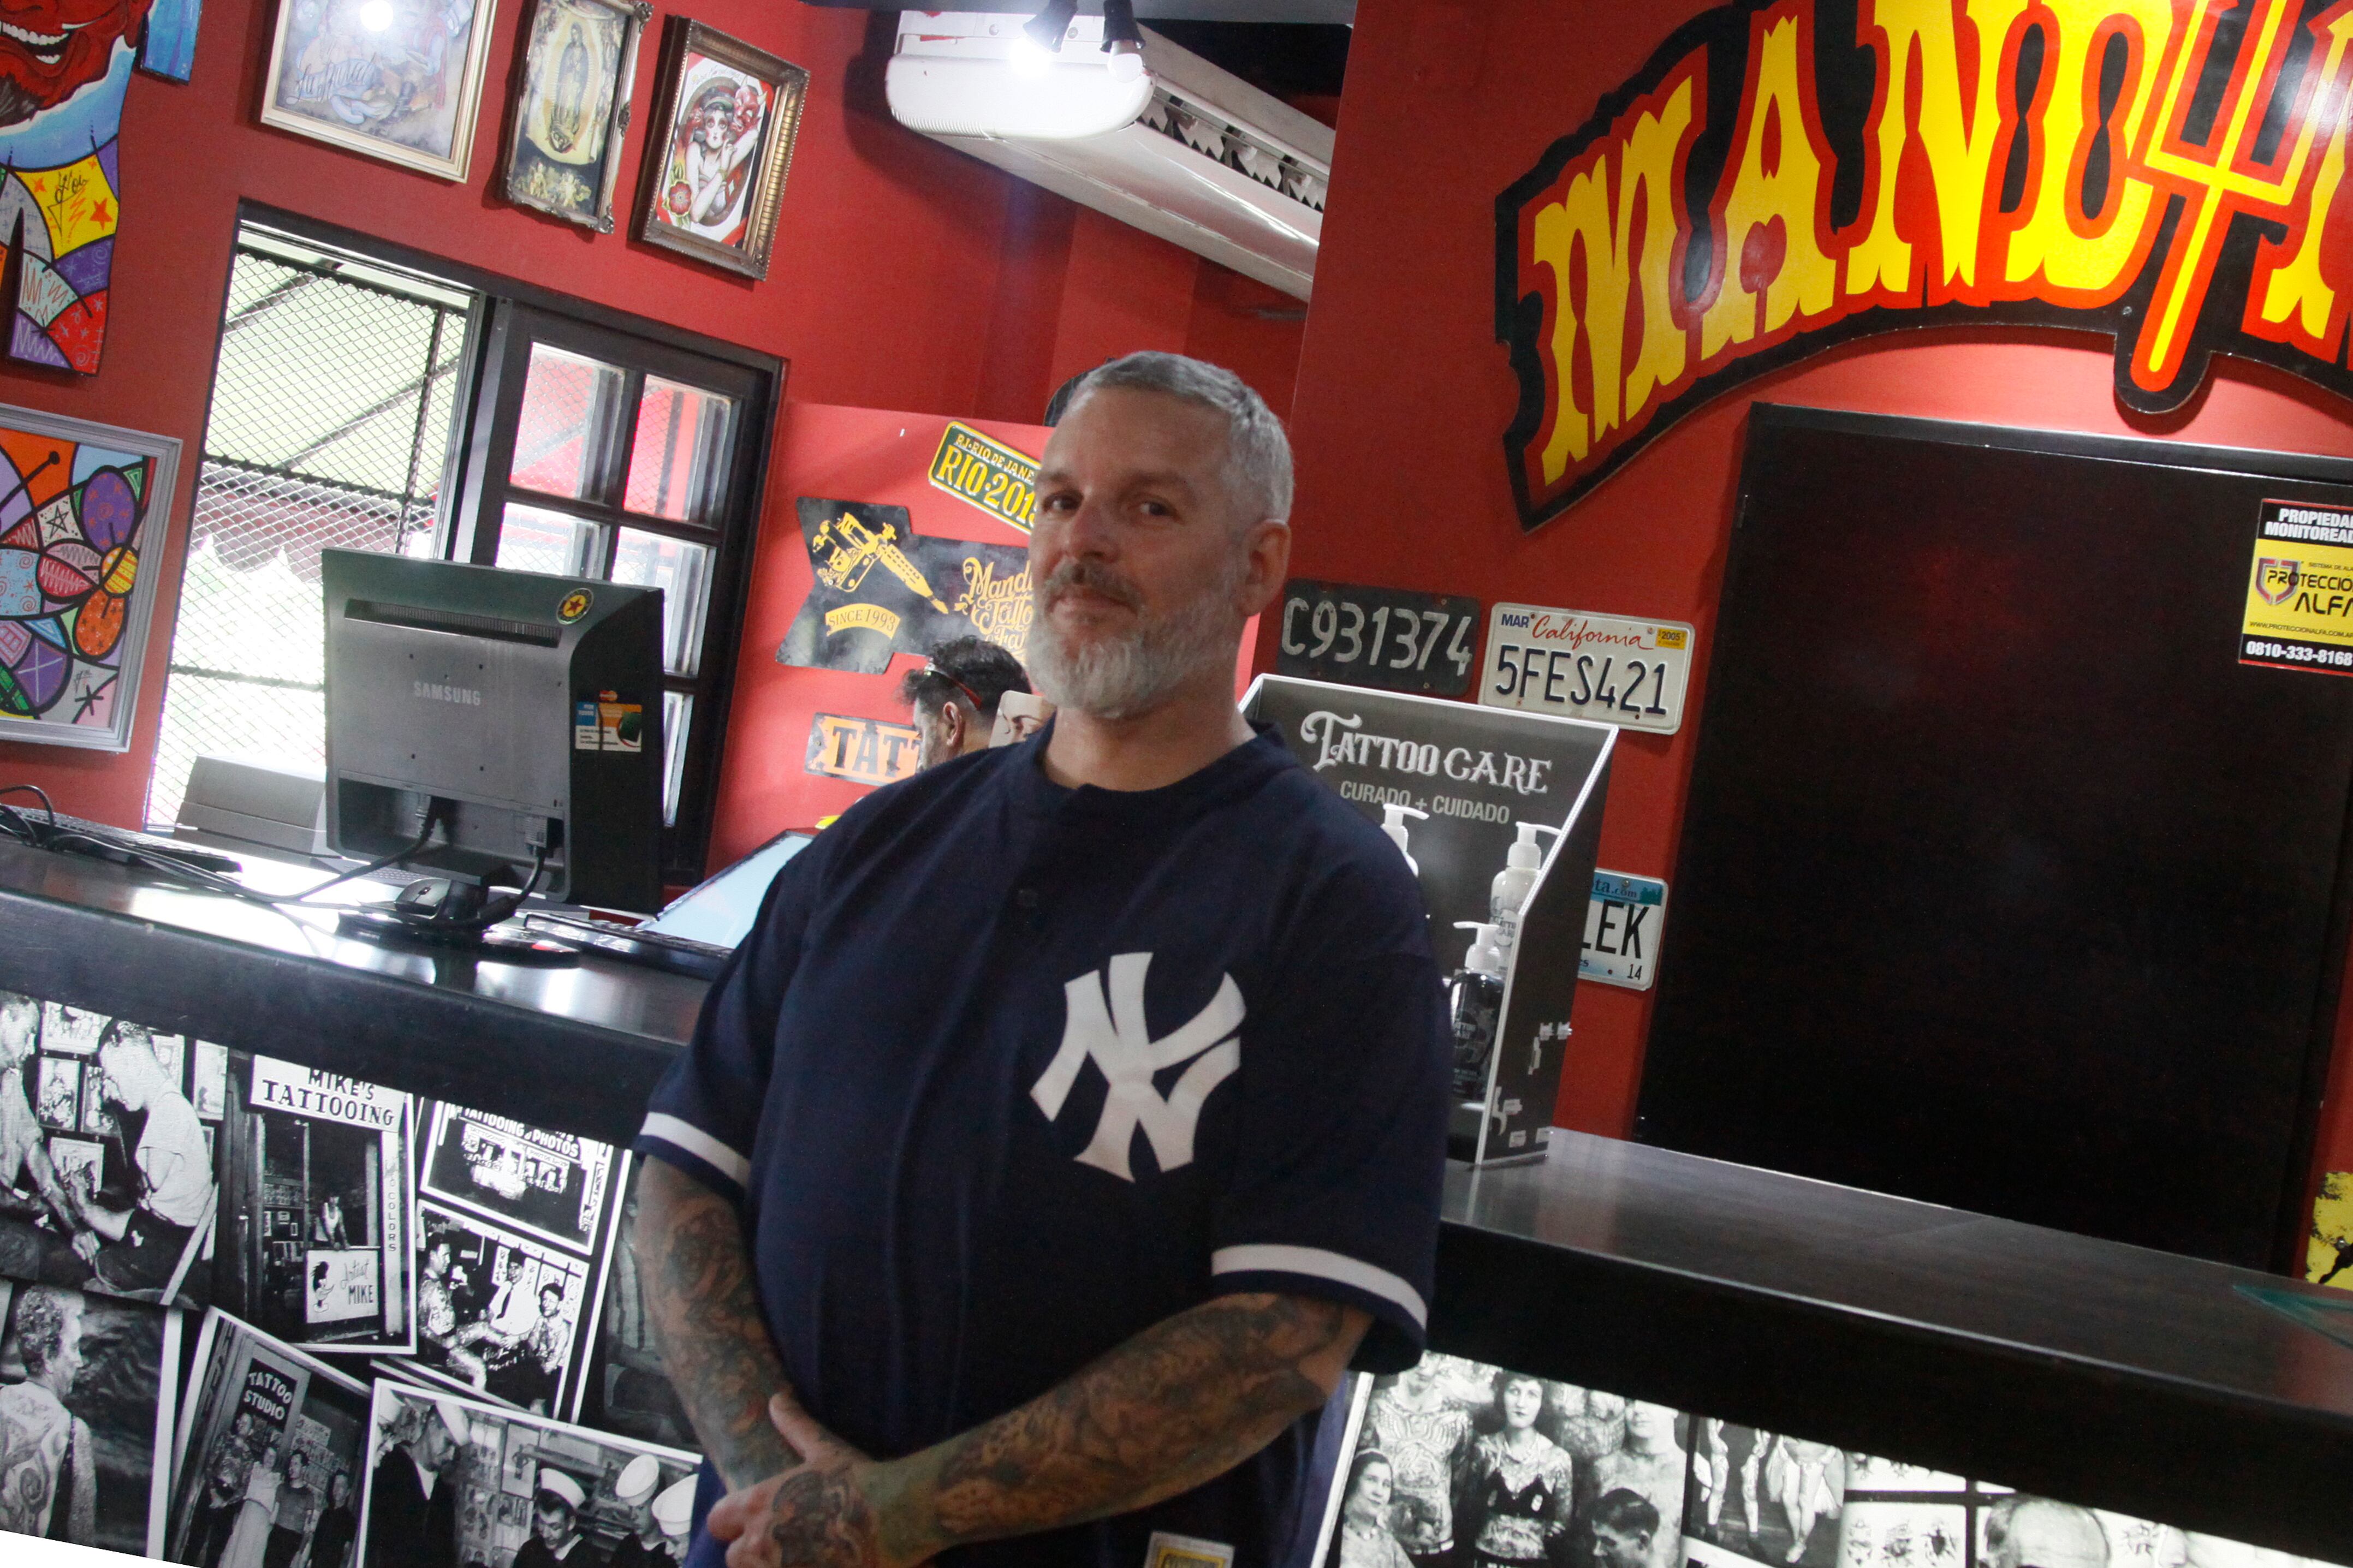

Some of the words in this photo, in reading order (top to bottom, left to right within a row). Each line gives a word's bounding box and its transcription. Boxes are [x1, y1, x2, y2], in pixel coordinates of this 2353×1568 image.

[991, 453, 1006, 468] DE
[2278, 508, 2353, 529] PROPIEDA
[829, 609, 863, 627] SINCE
[865, 608, 896, 632] 1993
[1501, 613, 1529, 628] MAR
[1532, 615, 1654, 651] California
[1661, 630, 1681, 641] 2005
[1281, 597, 1473, 677] C931374
[414, 681, 482, 706] SAMSUNG
[1495, 644, 1667, 716] 5FES421
[1443, 747, 1553, 795] CARE
[1340, 780, 1411, 808] CURADO
[1432, 795, 1511, 825] CUIDADO
[1583, 898, 1650, 959] EK
[1627, 963, 1643, 981] 14
[1029, 951, 1247, 1183] NY
[262, 1078, 395, 1126] TATTOOING
[531, 1129, 579, 1158] PHOTOS
[348, 1284, 373, 1305] MIKE
[248, 1372, 293, 1404] TATTOO
[243, 1389, 286, 1421] STUDIO
